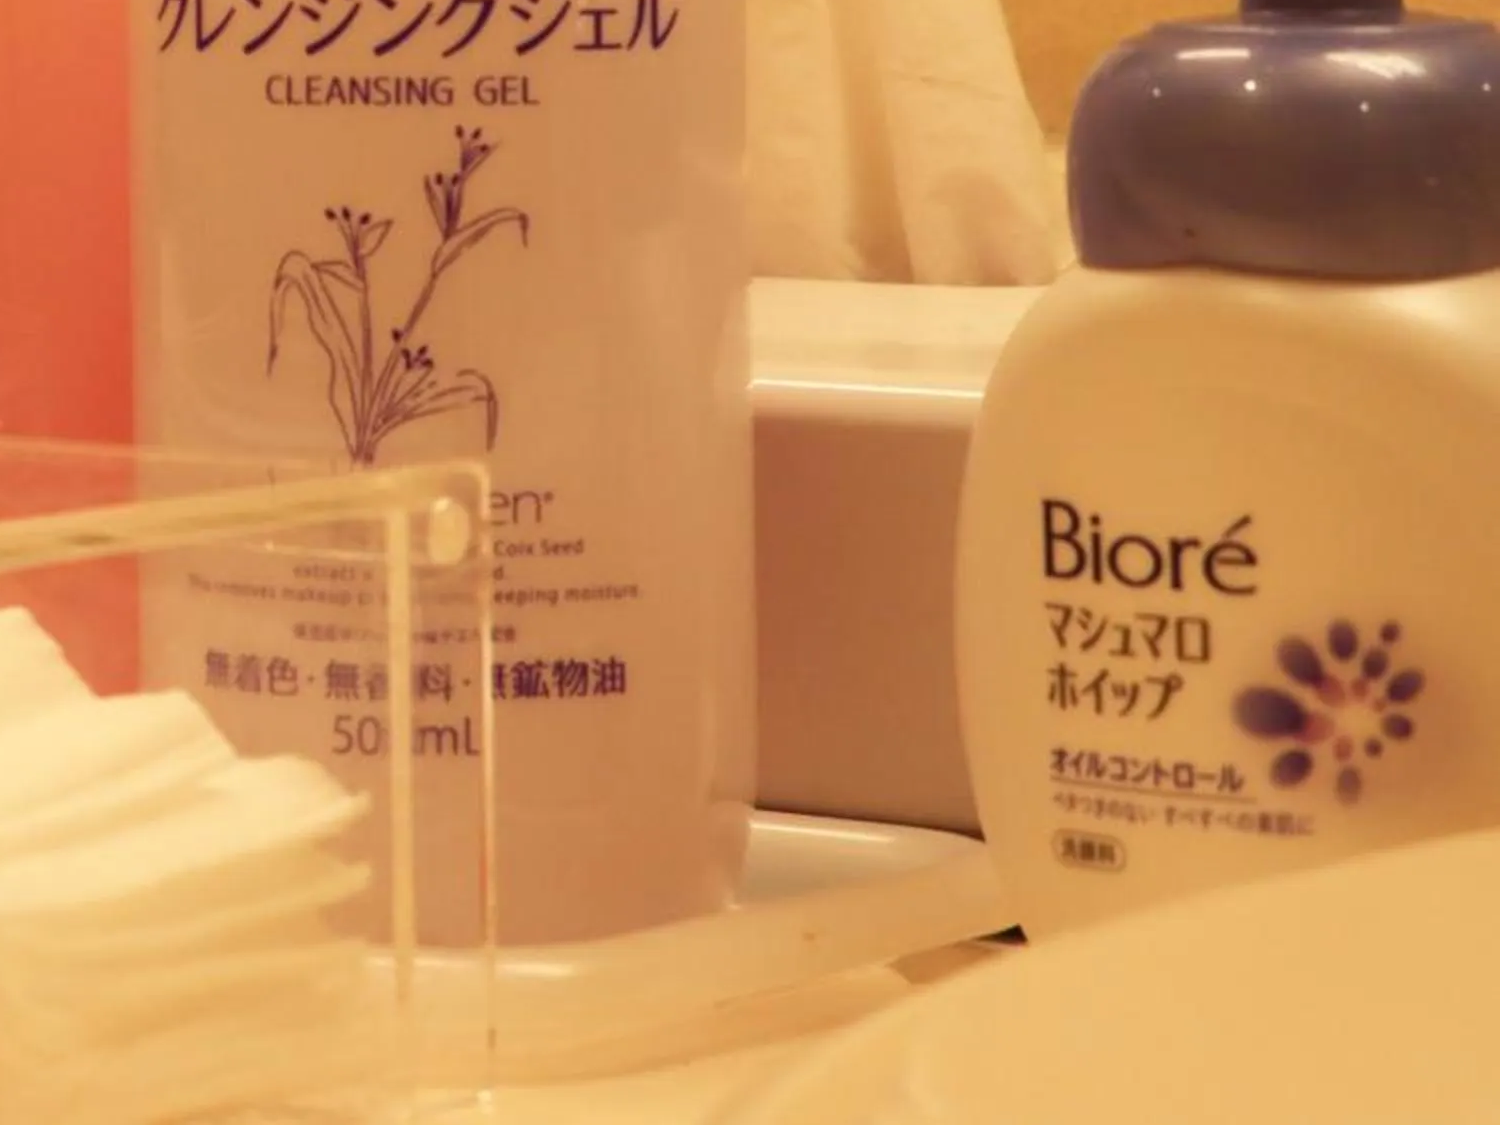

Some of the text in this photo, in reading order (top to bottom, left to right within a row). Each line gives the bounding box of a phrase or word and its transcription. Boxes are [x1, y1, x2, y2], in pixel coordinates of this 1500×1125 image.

[265, 75, 540, 106] CLEANSING GEL
[1041, 498, 1258, 597] Bioré
[1044, 602, 1211, 665] マシュマロ
[1046, 663, 1185, 721] ホイップ
[332, 715, 481, 757] 50mL
[1050, 748, 1245, 794] オイルコントロール
